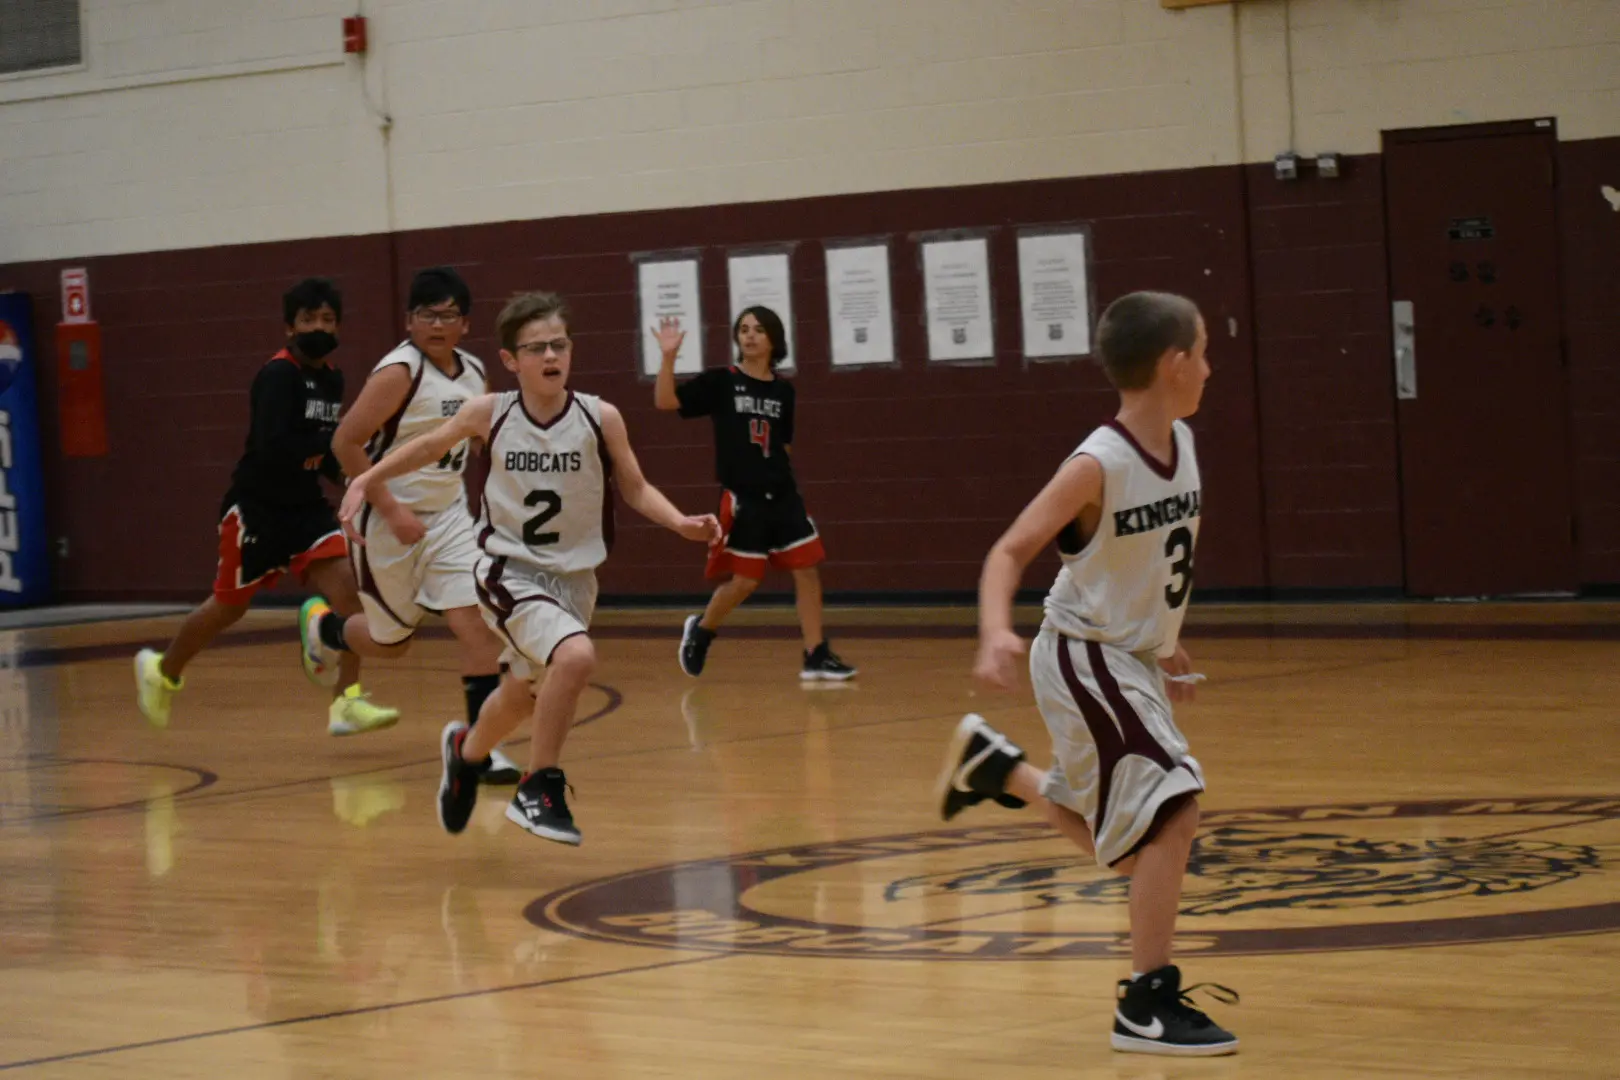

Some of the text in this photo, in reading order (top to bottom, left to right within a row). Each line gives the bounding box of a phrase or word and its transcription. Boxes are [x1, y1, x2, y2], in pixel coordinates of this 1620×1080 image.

[734, 396, 781, 418] WALLACE
[749, 418, 770, 458] 4
[505, 451, 581, 473] BOBCATS
[522, 489, 562, 546] 2
[1164, 526, 1193, 610] 3
[598, 908, 1221, 955] BOBCATS
